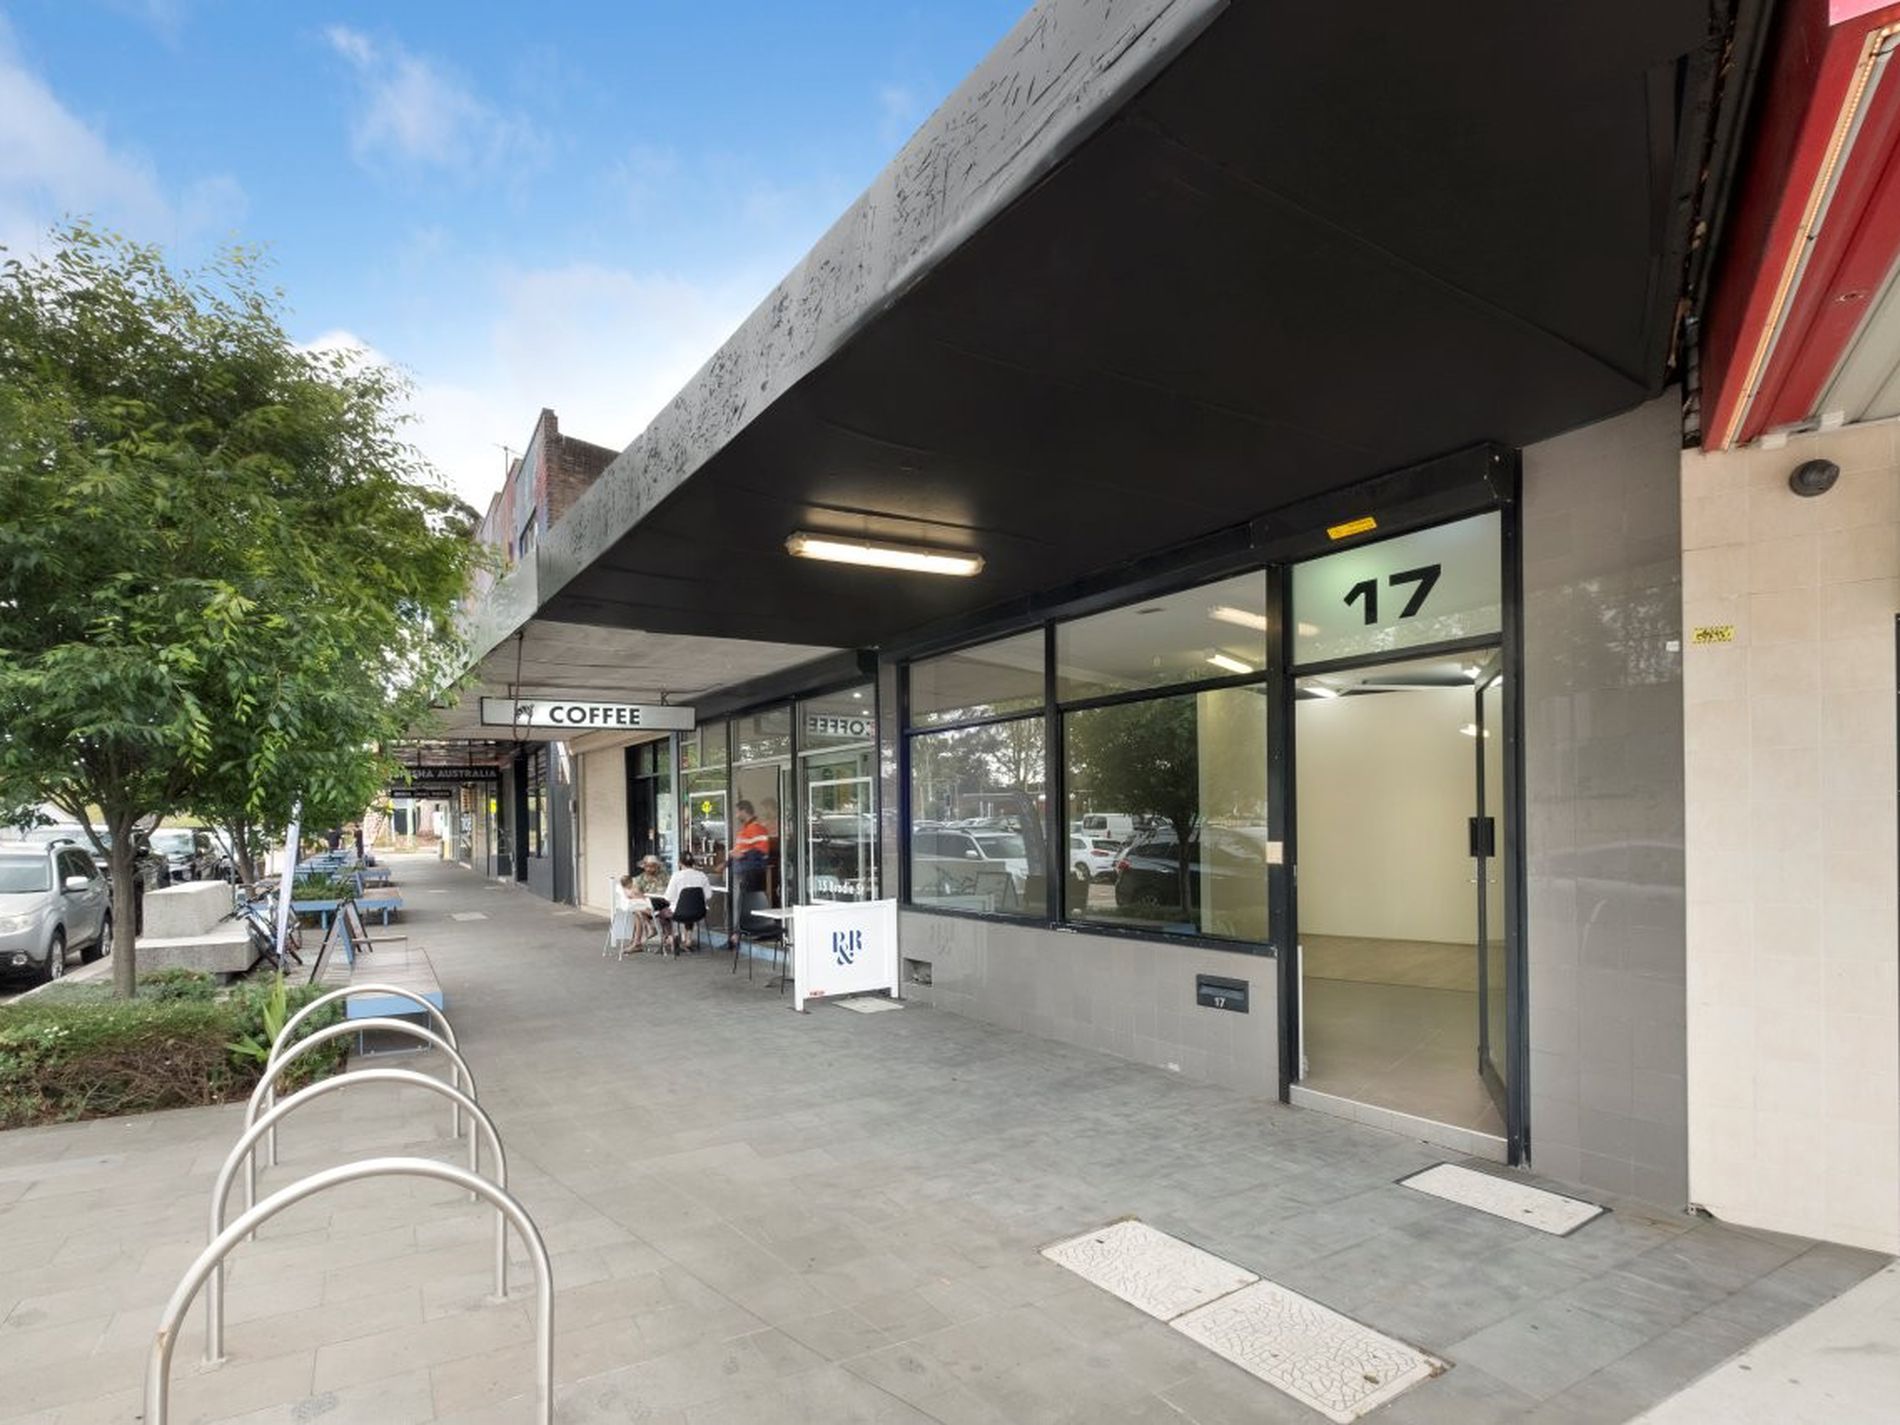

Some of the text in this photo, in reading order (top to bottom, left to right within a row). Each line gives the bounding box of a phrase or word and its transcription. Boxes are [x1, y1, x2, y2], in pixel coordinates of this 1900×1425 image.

[1343, 563, 1442, 626] 17
[550, 705, 641, 725] COFFEE
[437, 769, 497, 778] AUSTRALIA
[1214, 996, 1226, 1008] 17
